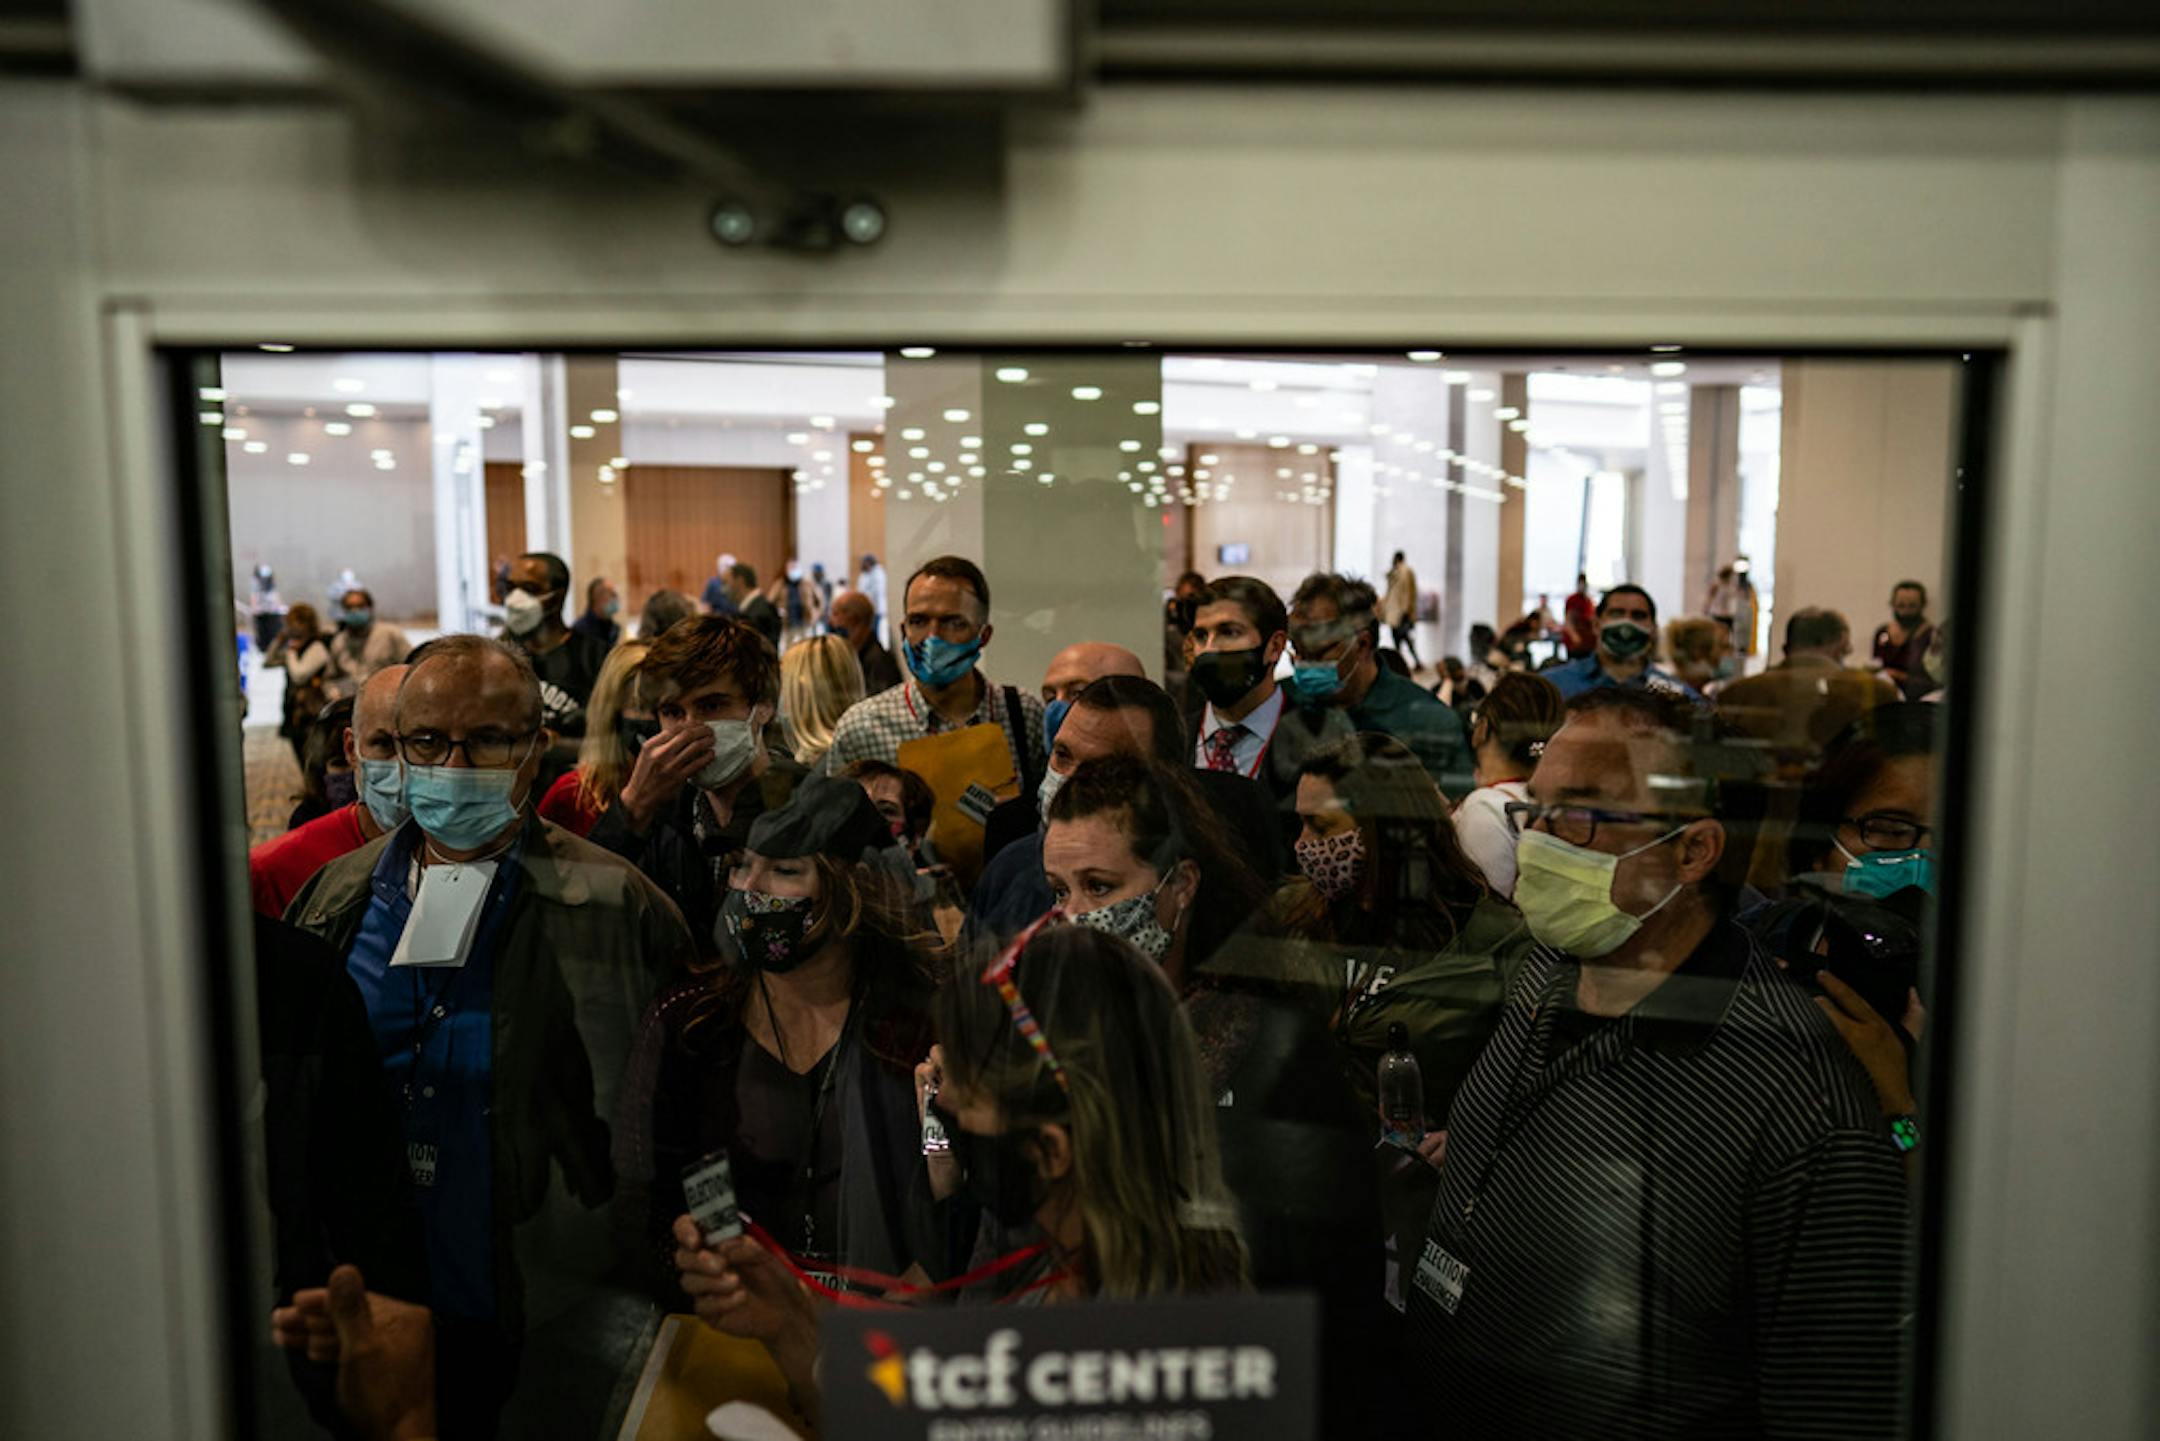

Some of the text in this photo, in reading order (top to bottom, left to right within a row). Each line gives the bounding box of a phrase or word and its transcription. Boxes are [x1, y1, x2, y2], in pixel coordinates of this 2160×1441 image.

[1418, 1241, 1468, 1285] ELECTION
[908, 1328, 1277, 1410] tcf CENTER
